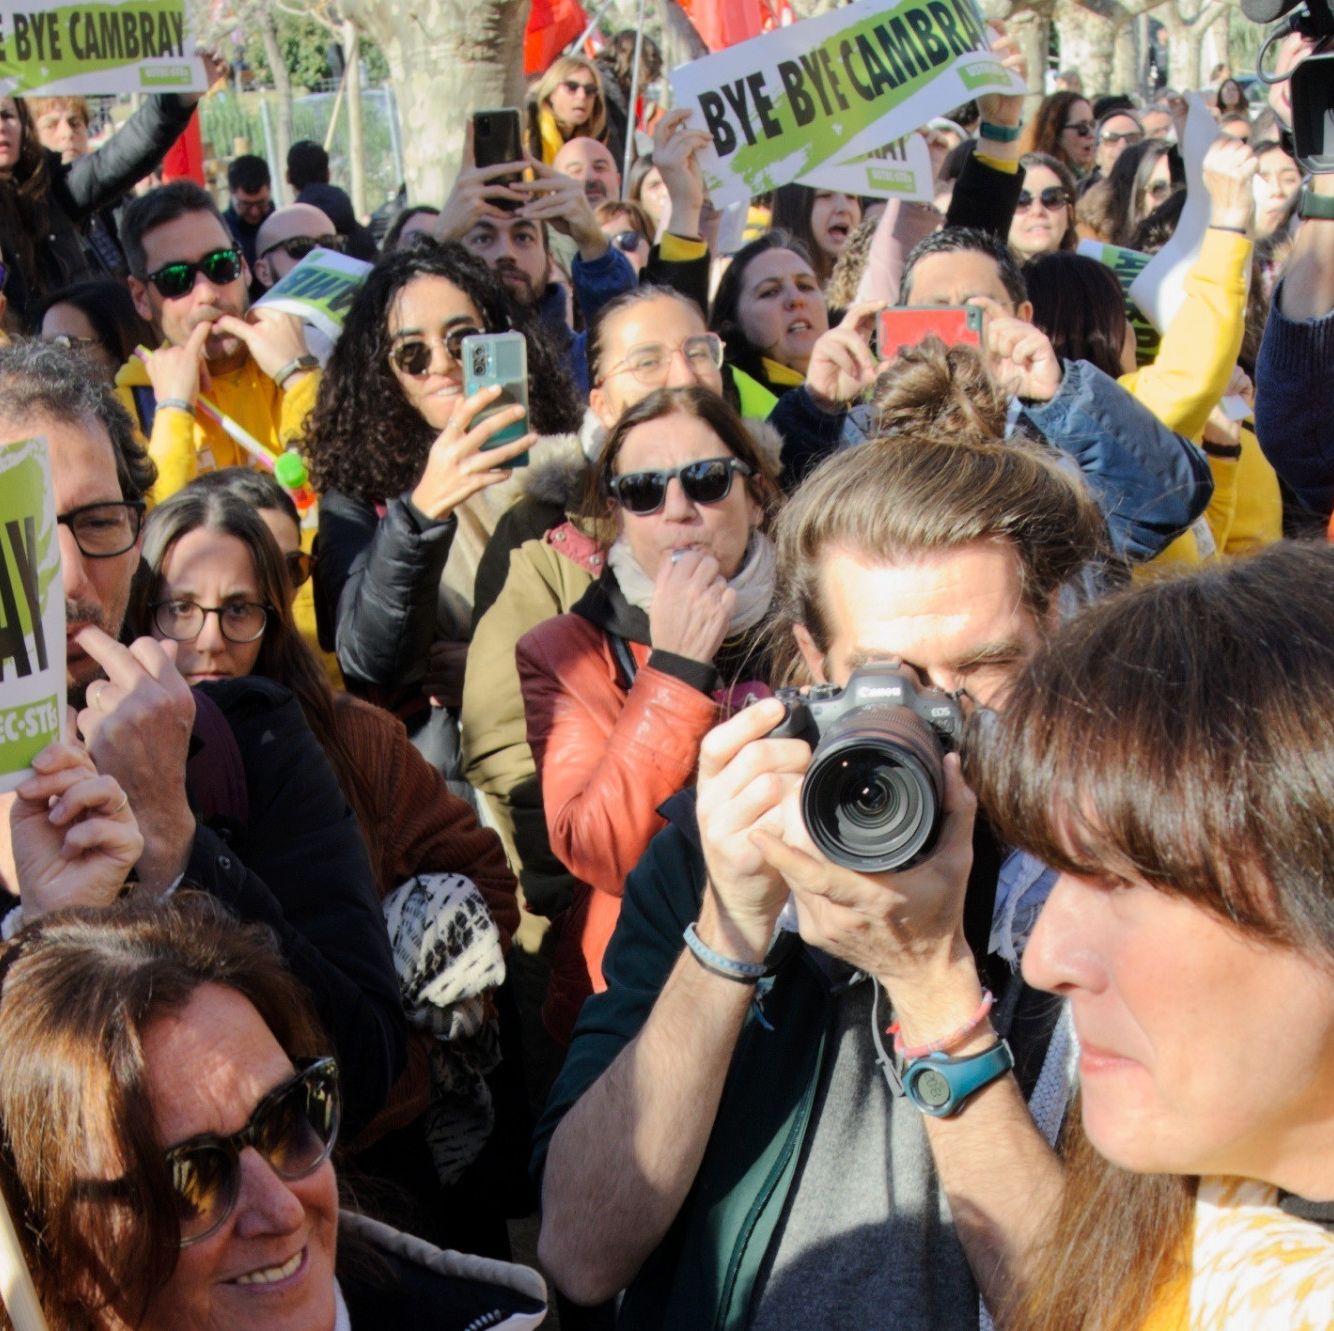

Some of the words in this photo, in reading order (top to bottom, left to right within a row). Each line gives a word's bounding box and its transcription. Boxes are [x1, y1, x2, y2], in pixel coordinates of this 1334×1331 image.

[13, 12, 62, 61] BYE
[69, 11, 184, 60] CAMBRAY
[697, 71, 783, 158] BYE
[777, 48, 851, 127] BYE
[858, 686, 902, 698] Canon
[931, 707, 951, 717] EOS
